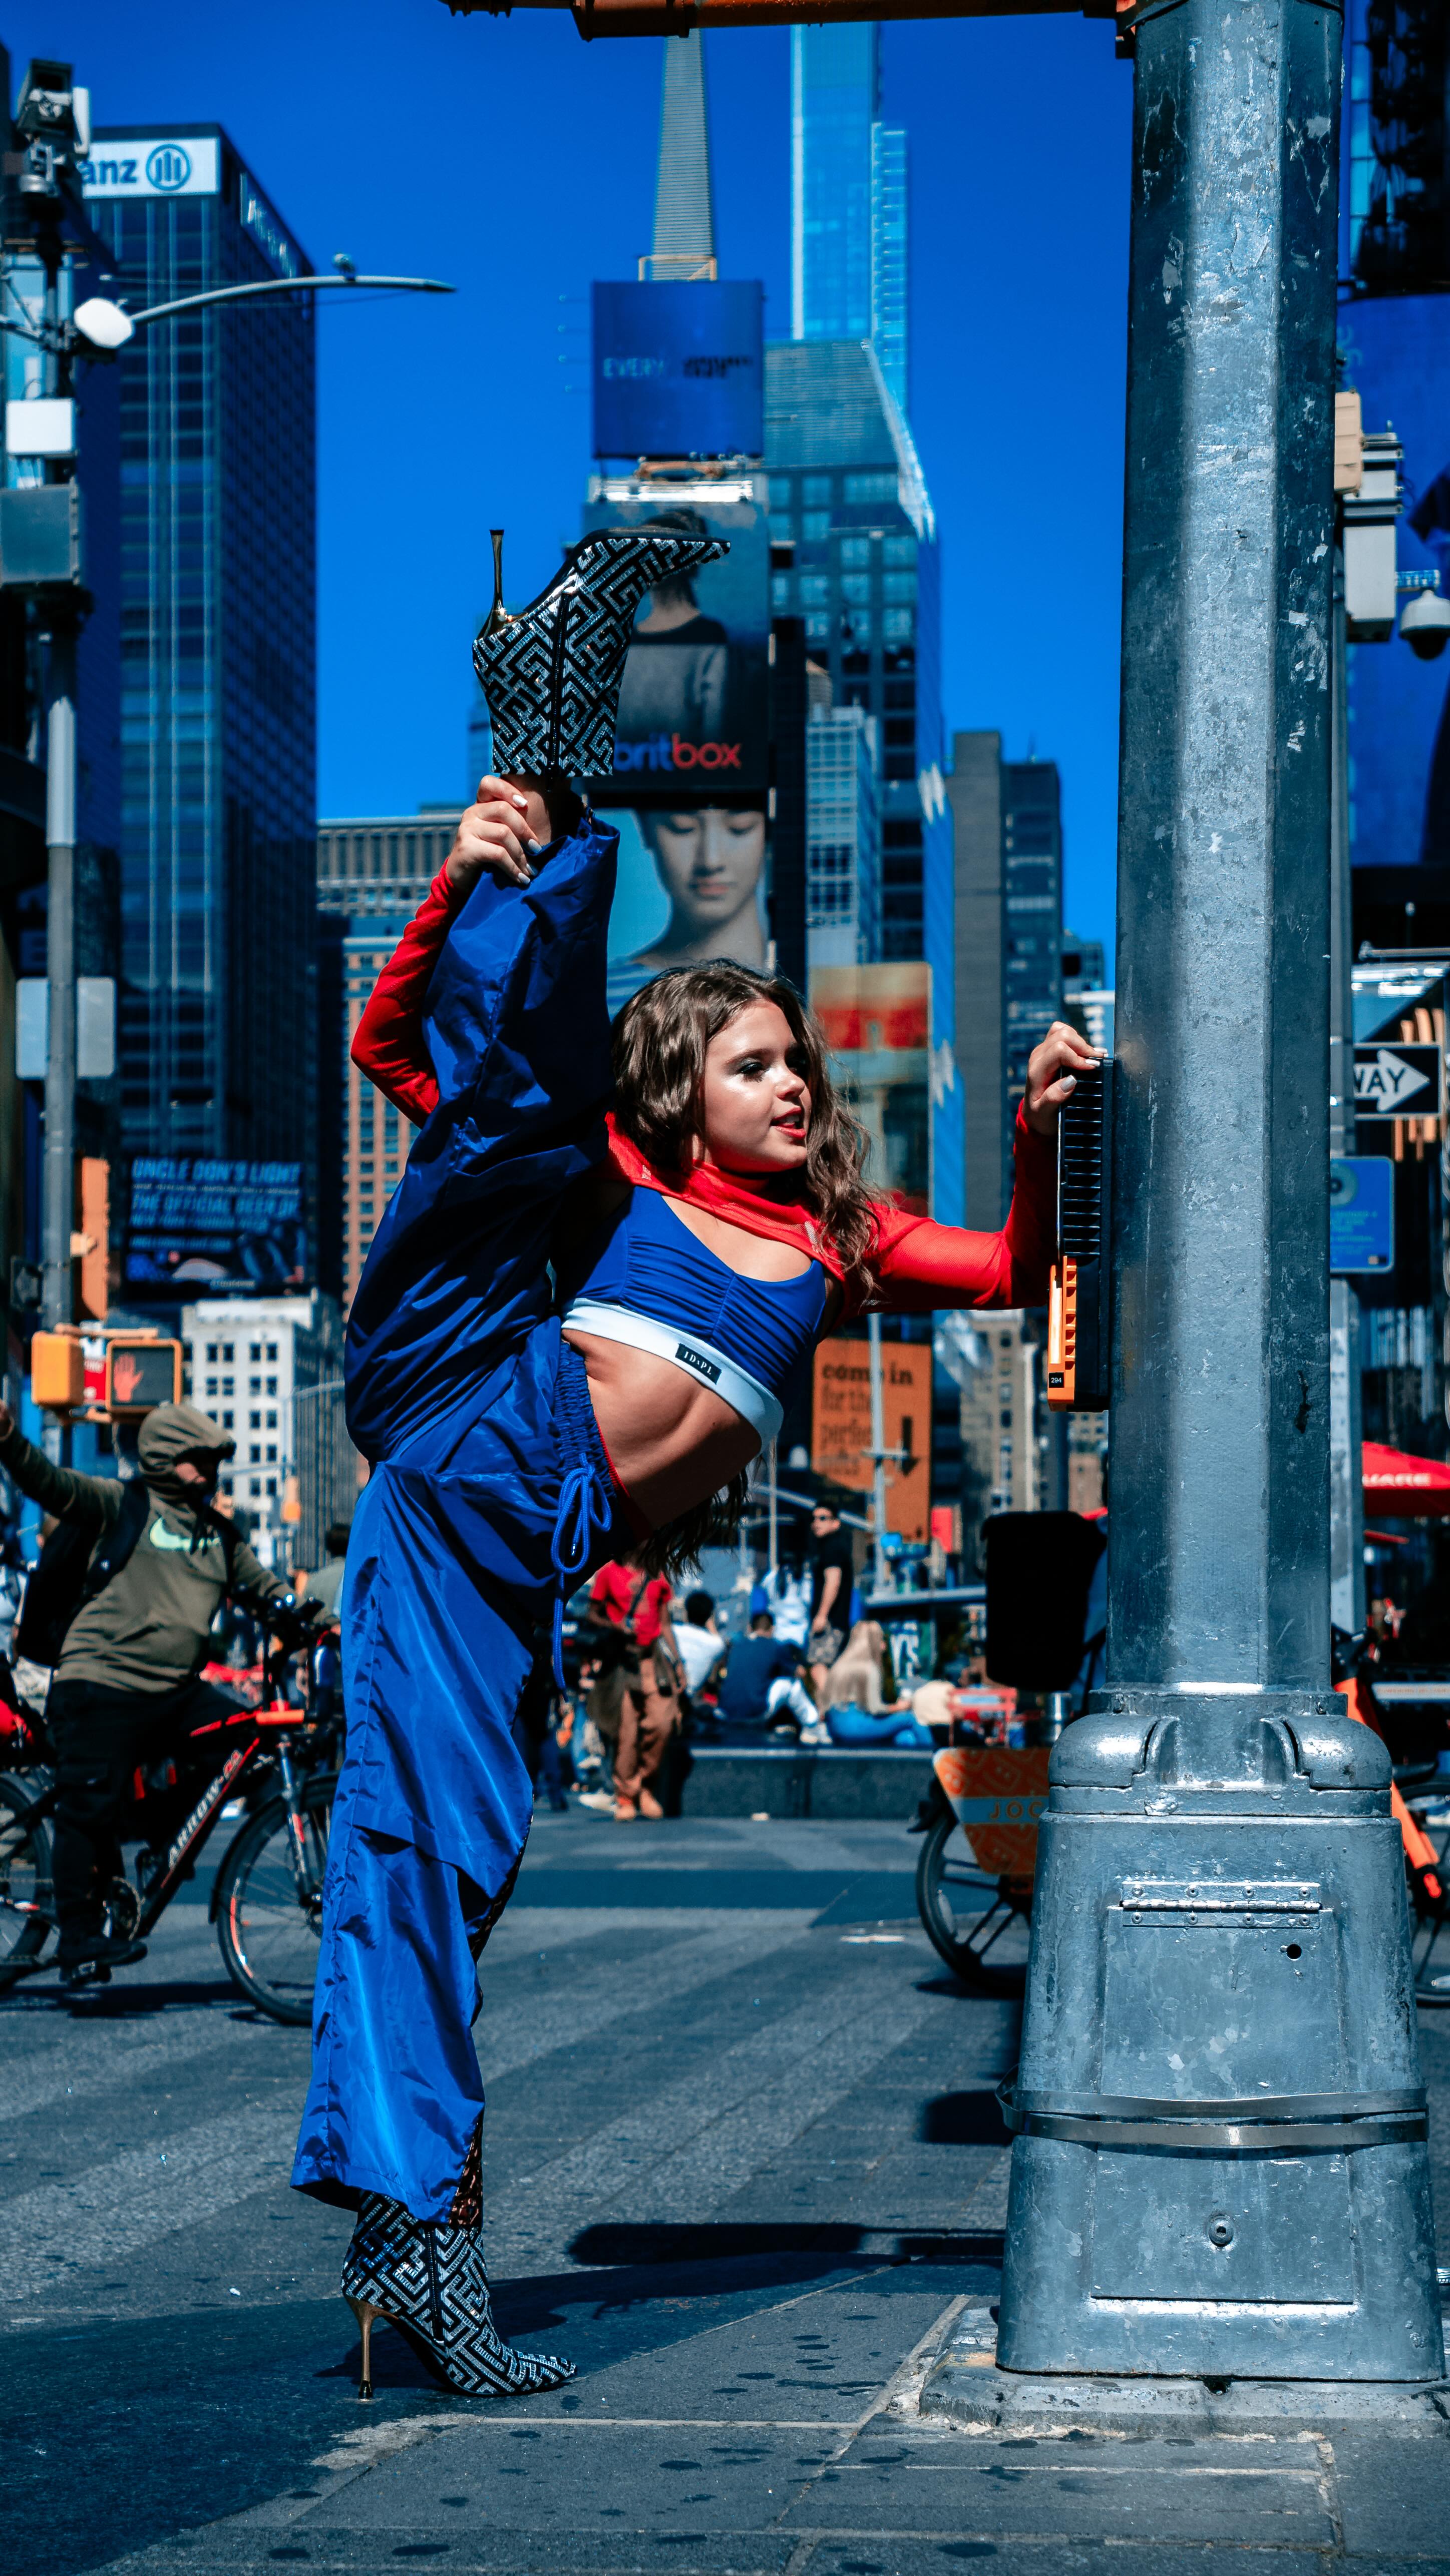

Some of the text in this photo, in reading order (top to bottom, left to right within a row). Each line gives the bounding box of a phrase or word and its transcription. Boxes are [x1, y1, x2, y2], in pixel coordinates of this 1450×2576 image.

[603, 357, 665, 376] EVERY
[132, 1157, 190, 1179] UNCLE
[132, 1193, 161, 1210] THE
[163, 1194, 230, 1213] OFFICIAL
[890, 1361, 913, 1386] in
[990, 1801, 1042, 1819] JOC
